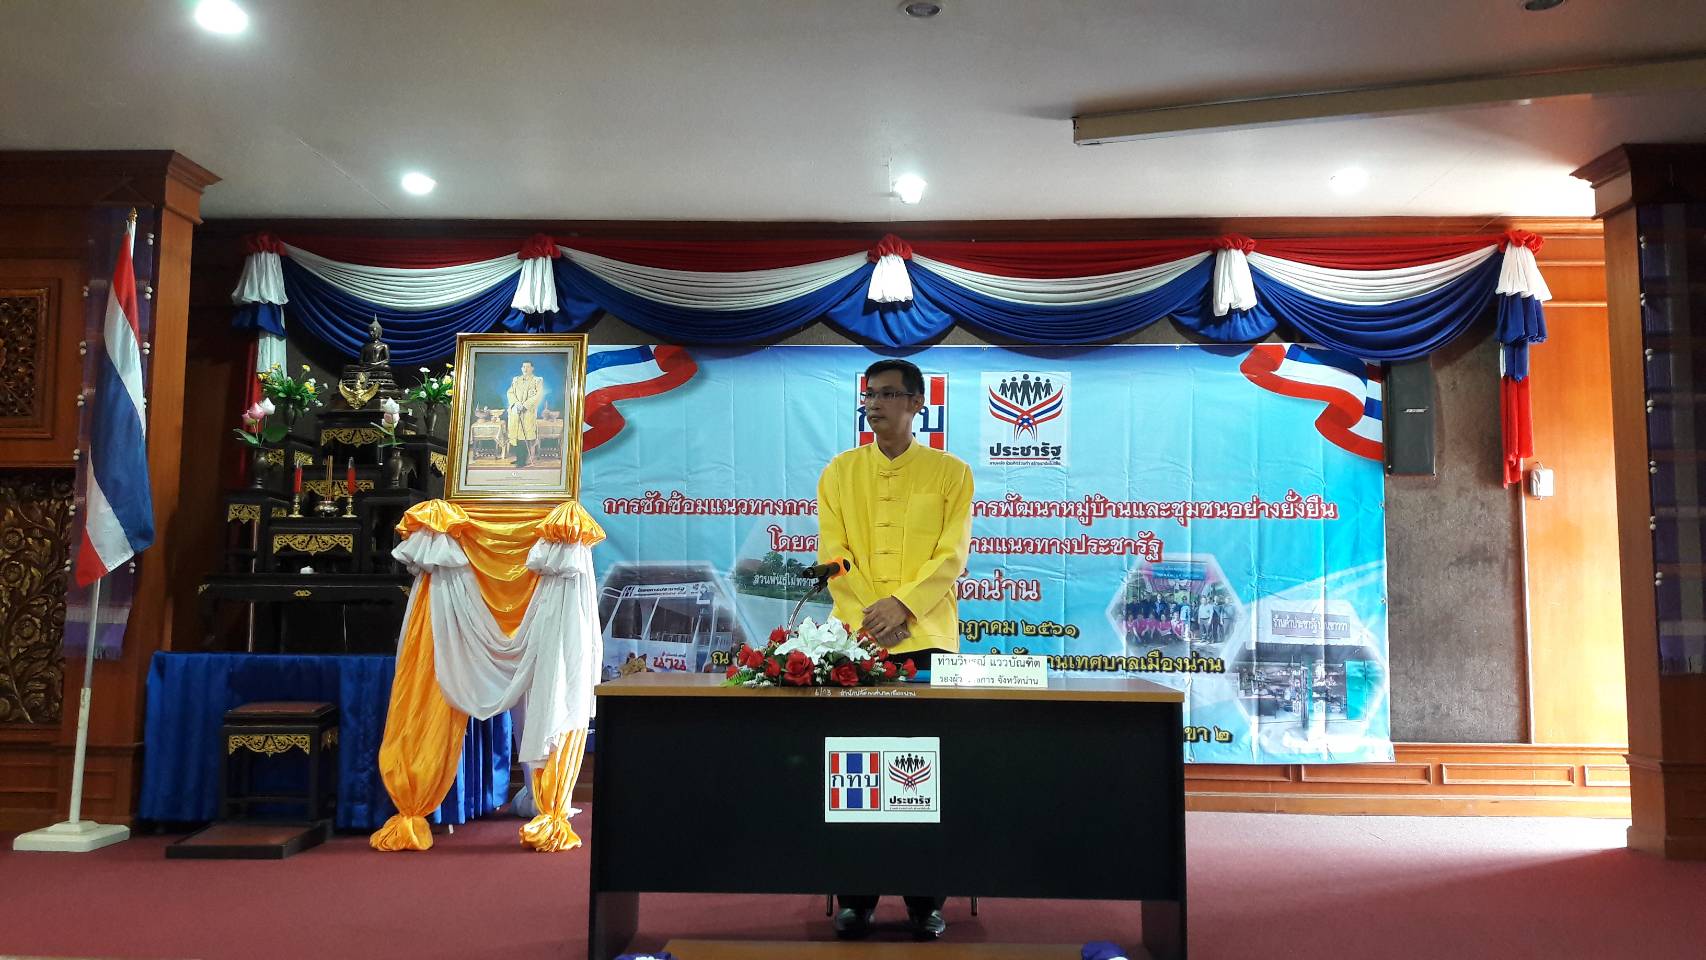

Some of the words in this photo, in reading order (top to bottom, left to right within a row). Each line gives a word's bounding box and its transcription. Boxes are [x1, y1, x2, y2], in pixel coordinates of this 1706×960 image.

[990, 442, 1062, 460] ประชารัฐ
[832, 774, 879, 788] กทบ
[889, 795, 931, 805] ประชารัฐ
